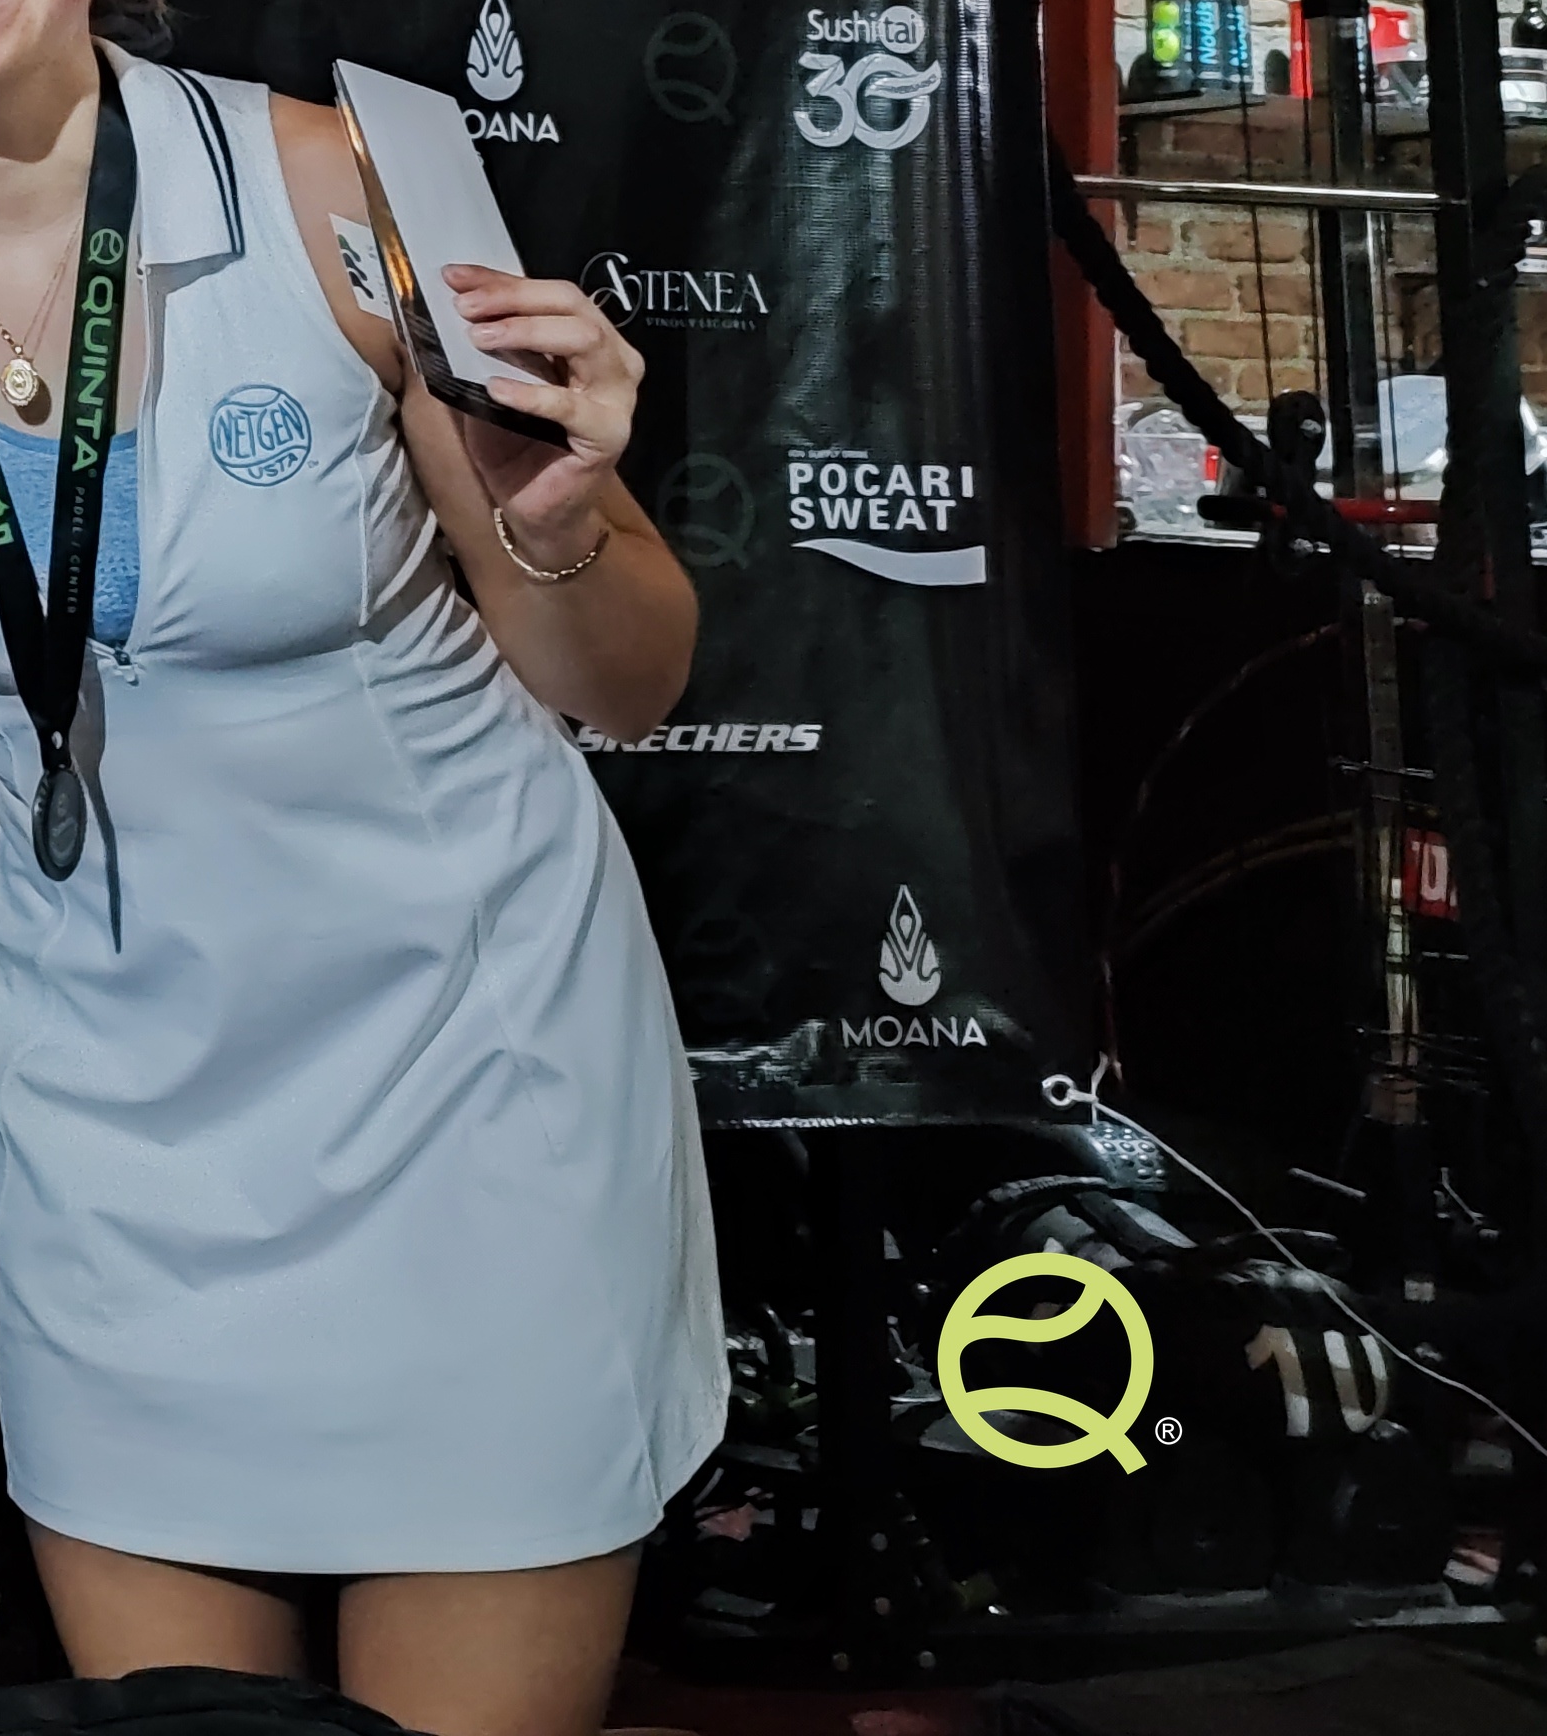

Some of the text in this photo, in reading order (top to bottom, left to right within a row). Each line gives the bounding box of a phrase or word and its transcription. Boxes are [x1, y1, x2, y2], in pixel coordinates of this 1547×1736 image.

[463, 108, 560, 144] OANA
[72, 275, 115, 472] QUINTA
[216, 400, 305, 459] NETGEN
[248, 452, 299, 480] USTA
[788, 462, 975, 498] POCARI
[73, 486, 86, 535] PADEL
[789, 496, 957, 532] SWEAT
[67, 553, 82, 615] CENTER
[842, 1015, 987, 1048] MOANA
